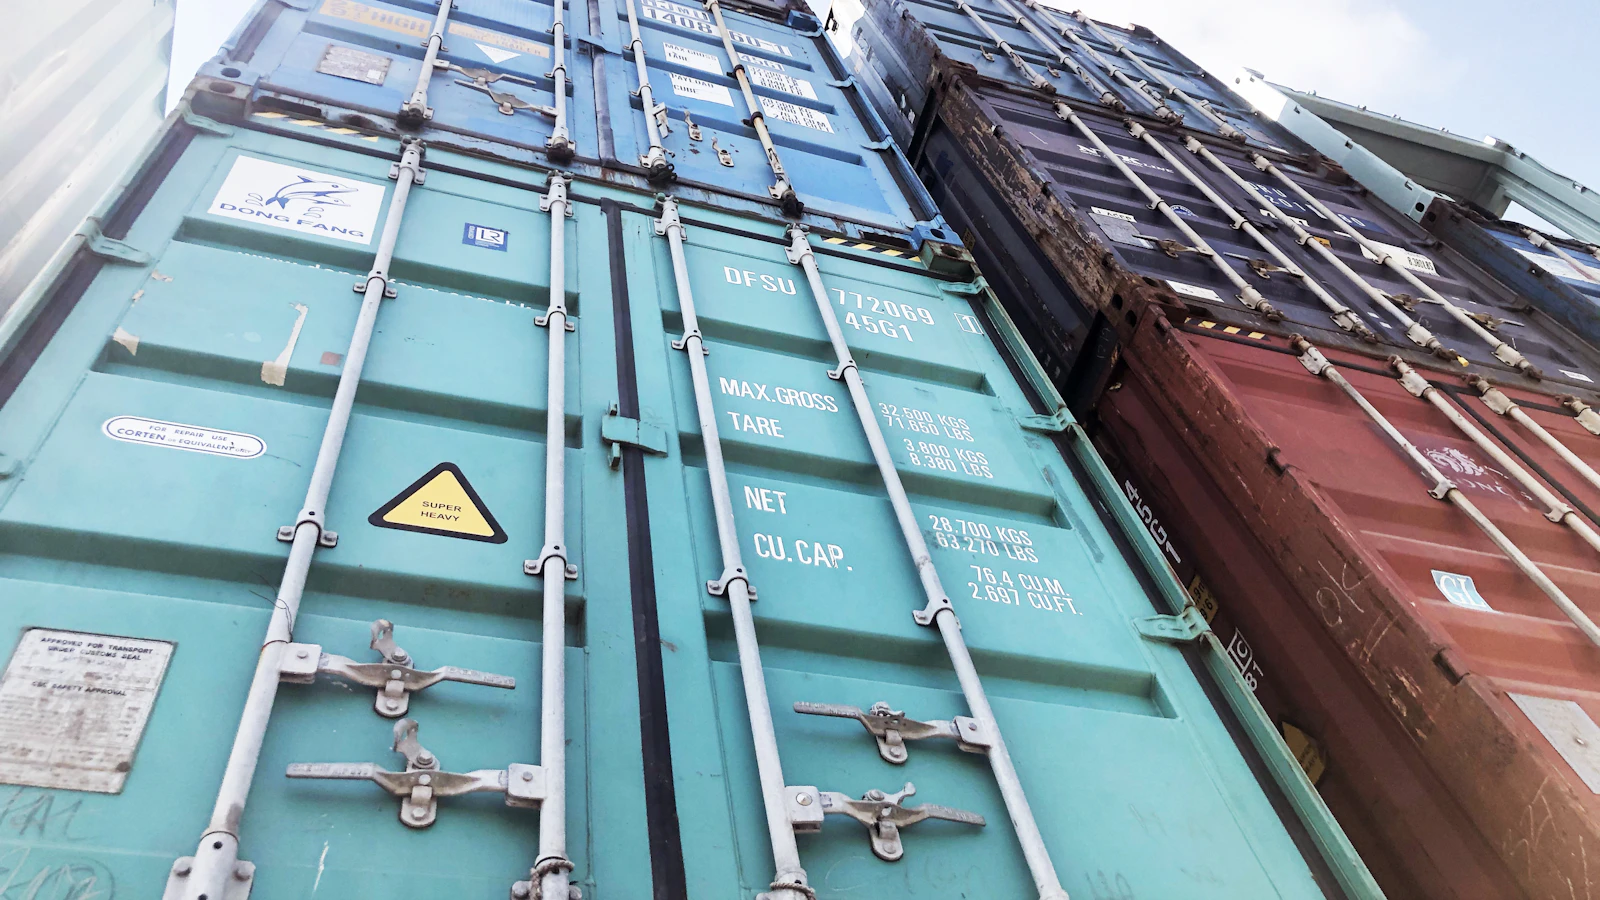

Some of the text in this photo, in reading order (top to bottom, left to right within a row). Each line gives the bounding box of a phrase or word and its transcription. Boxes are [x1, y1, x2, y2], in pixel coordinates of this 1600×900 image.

[219, 203, 364, 238] DONG FANG
[723, 266, 797, 295] DFSU
[831, 288, 935, 325] 772069
[845, 312, 913, 342] 45G1
[719, 377, 839, 413] MAX.GROSS
[727, 411, 784, 438] TARE
[879, 402, 970, 430] 32.500 KGS
[883, 414, 975, 442] 71.650 LBS
[117, 428, 166, 441] CORTEN
[178, 438, 235, 452] EQUIVALENT
[174, 429, 204, 438] REPAIR
[903, 438, 989, 465] 3.800 KGS
[909, 452, 994, 479] 8.380 LBS
[422, 501, 462, 513] SUPER
[743, 485, 787, 514] NET
[420, 511, 460, 522] HEAVY
[928, 515, 1033, 546] 28.700 KGS
[1124, 480, 1181, 563] 45G1
[935, 532, 1039, 563] 63.270 LBS
[970, 565, 1071, 597] 76.4 CU.M.
[967, 582, 1083, 616] 2.697 CU.FT.
[40, 638, 83, 647] APPROVED
[108, 644, 153, 654] TRANSPORT
[80, 649, 117, 658] CUSTOMS
[52, 683, 83, 692] SAFETY
[85, 687, 127, 697] APPROVAL
